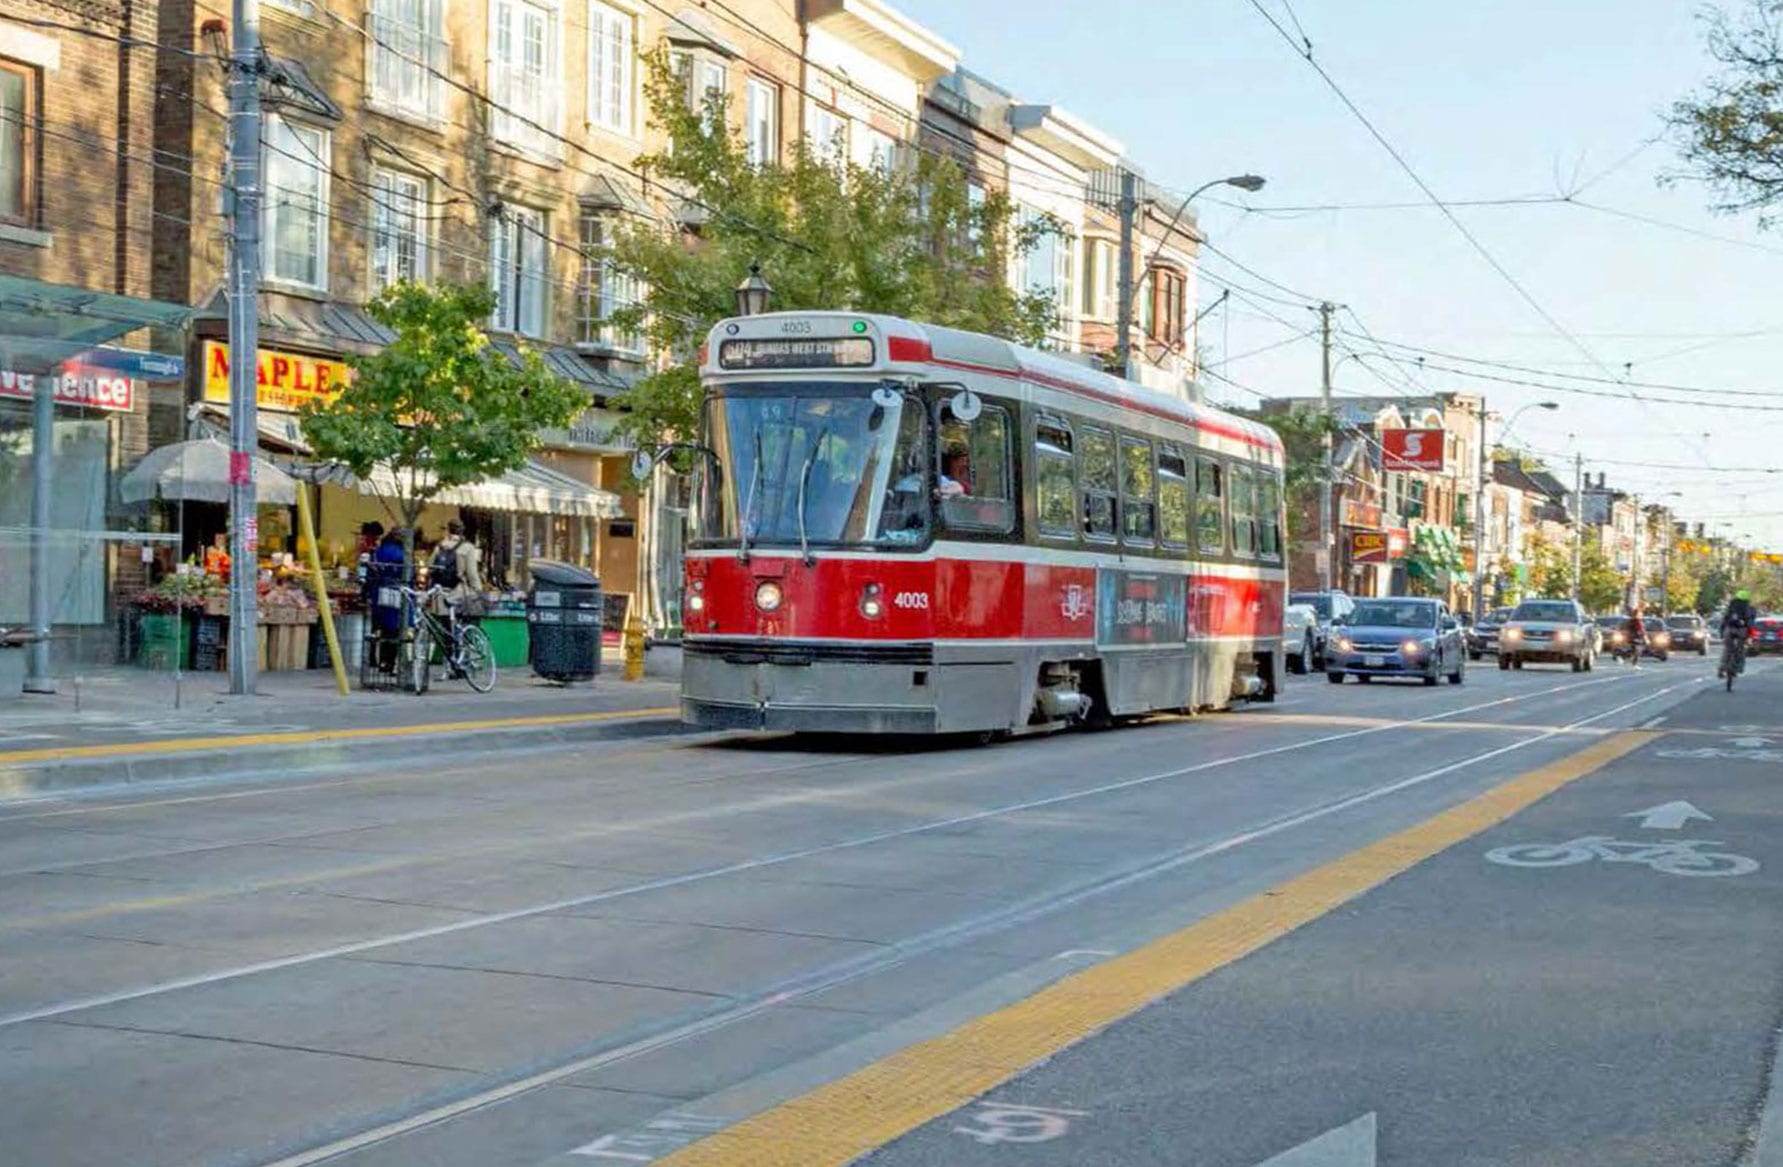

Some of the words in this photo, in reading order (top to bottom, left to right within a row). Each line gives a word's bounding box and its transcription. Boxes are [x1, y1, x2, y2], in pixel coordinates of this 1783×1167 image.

[781, 321, 811, 334] 4003
[1, 371, 128, 405] veience
[894, 592, 928, 609] 4003
